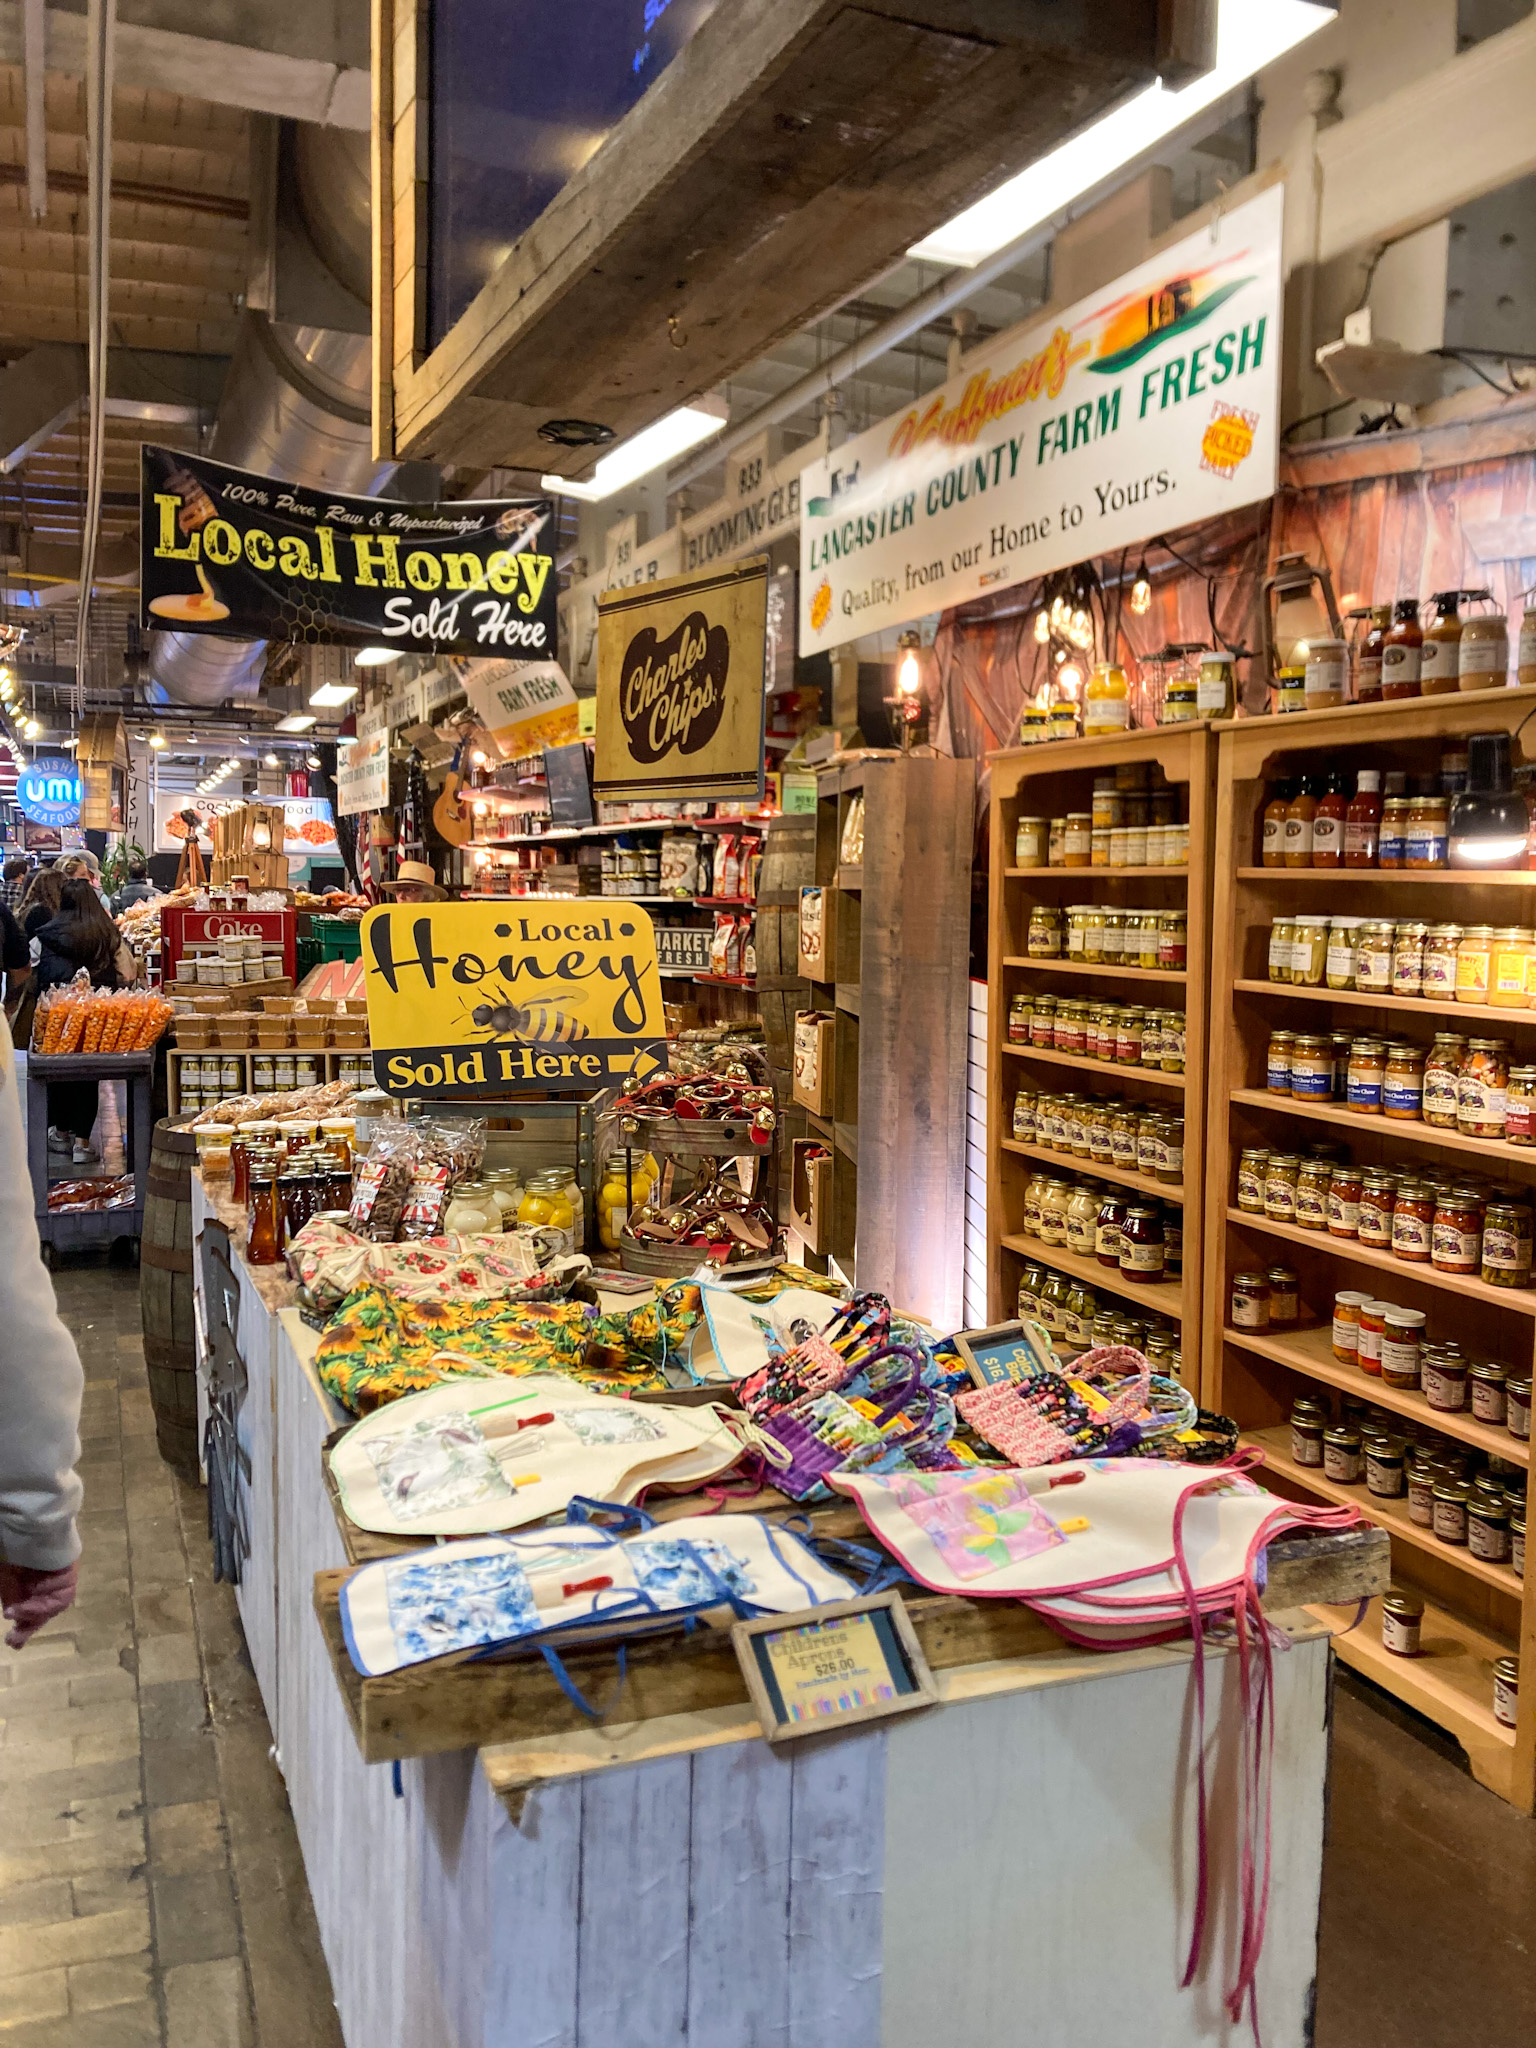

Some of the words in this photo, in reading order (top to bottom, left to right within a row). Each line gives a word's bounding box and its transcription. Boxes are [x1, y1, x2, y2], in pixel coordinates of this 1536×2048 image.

[810, 491, 916, 572] LANCASTER
[926, 431, 1025, 517] COUNTY
[1037, 386, 1122, 466] FARM
[1138, 314, 1268, 420] FRESH
[221, 483, 269, 505] 100%
[325, 505, 364, 524] Raw
[369, 511, 383, 527] &
[153, 493, 342, 583] Local
[351, 534, 553, 614] Honey
[842, 578, 900, 618] Quality,
[905, 562, 945, 591] from
[951, 542, 983, 573] our
[989, 521, 1051, 559] Home
[1061, 502, 1083, 531] to
[1094, 467, 1177, 517] Yours.
[381, 596, 461, 640] Sold
[472, 600, 548, 647] Here
[625, 625, 707, 722] Charles
[33, 760, 75, 774] SUSHI
[26, 804, 80, 823] SEAFOOD
[203, 915, 263, 940] Coke
[518, 918, 615, 941] Local
[655, 932, 712, 952] MARKET
[658, 952, 703, 965] FRESH
[370, 913, 652, 1034] Honey
[387, 1050, 487, 1089] Sold
[497, 1047, 602, 1082] Here
[1012, 1348, 1035, 1378] Color
[770, 1632, 849, 1658] Childrens
[788, 1648, 846, 1670] Aprons
[815, 1658, 855, 1677] $26.00
